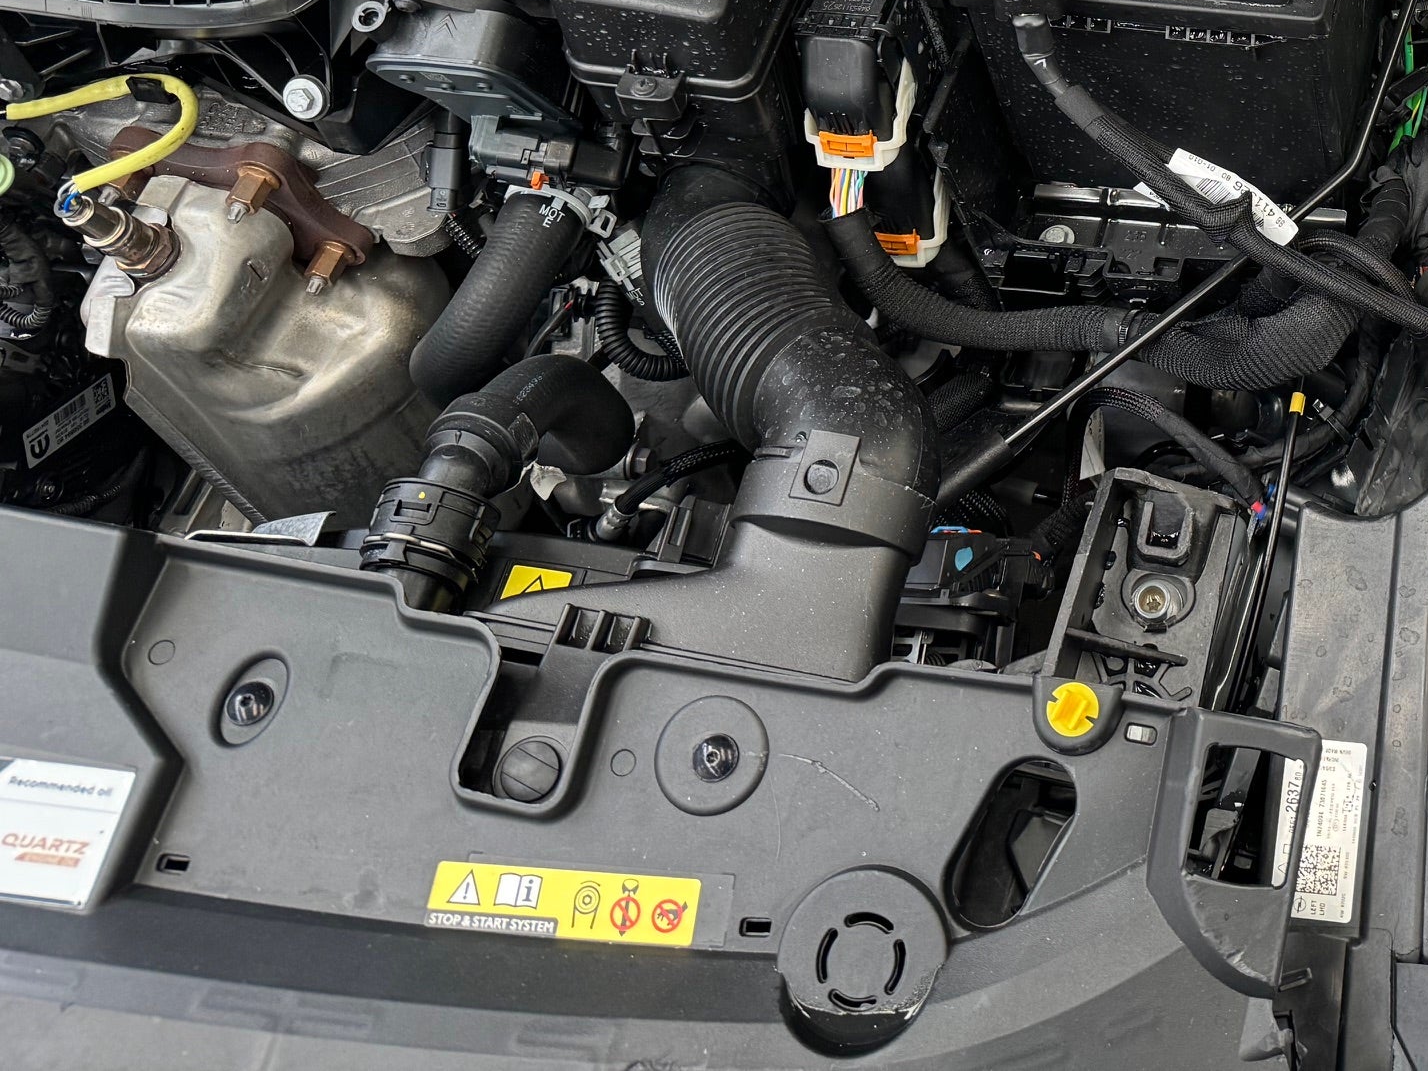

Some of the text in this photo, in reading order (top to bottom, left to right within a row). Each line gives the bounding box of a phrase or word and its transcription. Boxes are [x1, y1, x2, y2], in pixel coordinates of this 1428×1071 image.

[538, 203, 566, 223] MOT
[542, 217, 554, 228] E
[8, 775, 114, 797] Recommended oil
[1, 832, 91, 855] QUARTZ
[1318, 901, 1326, 916] LHD
[428, 912, 556, 934] STOP & START SYSTEM
